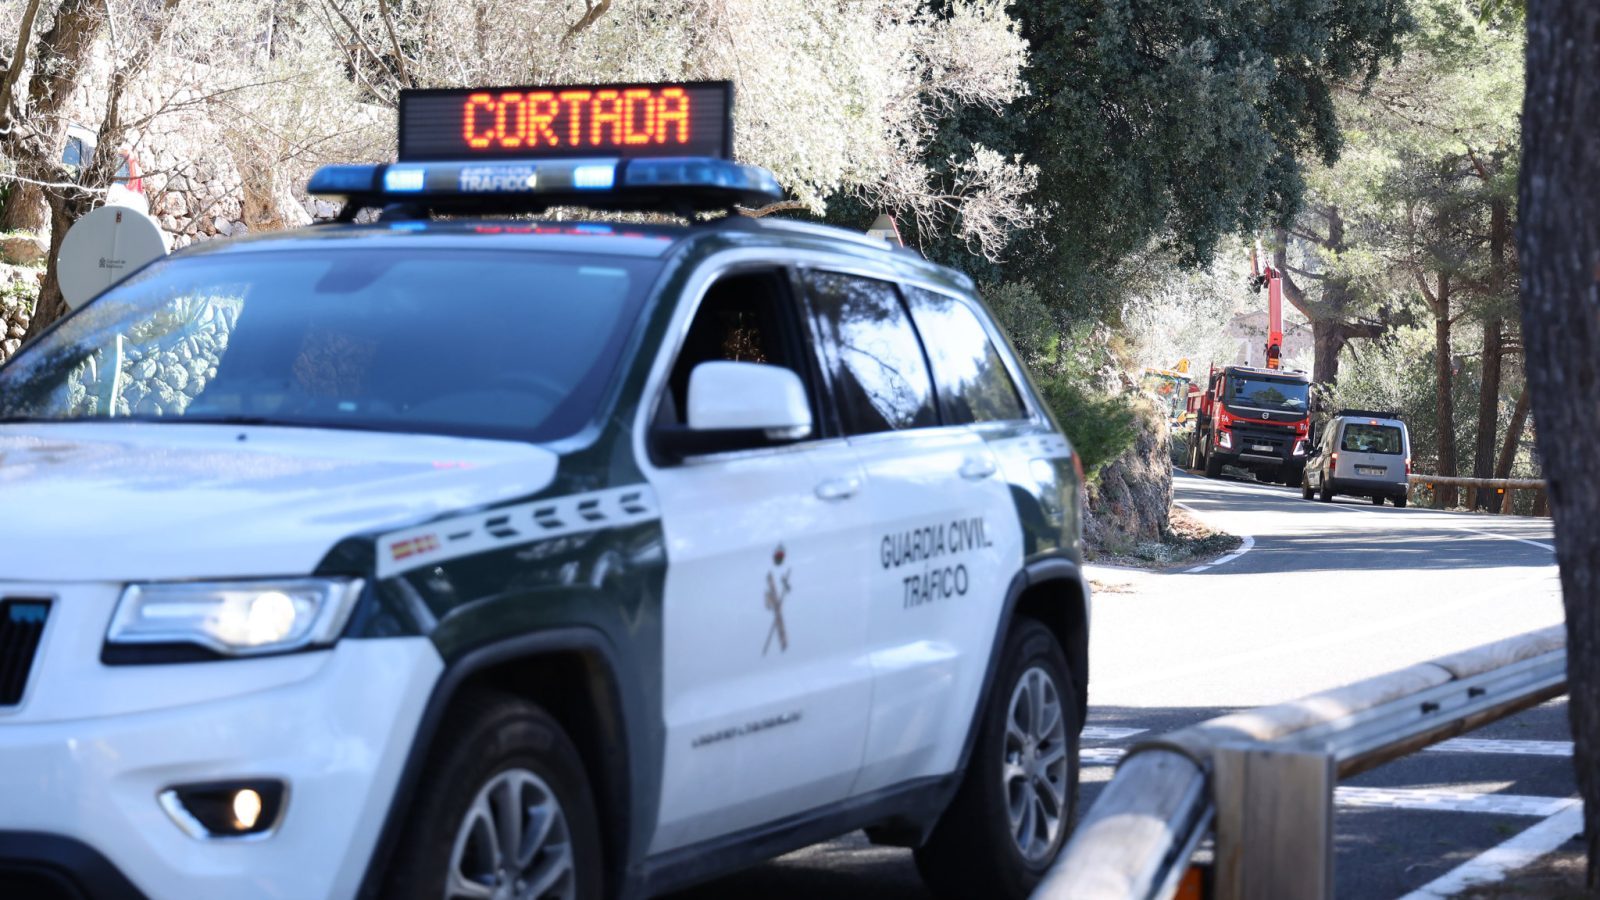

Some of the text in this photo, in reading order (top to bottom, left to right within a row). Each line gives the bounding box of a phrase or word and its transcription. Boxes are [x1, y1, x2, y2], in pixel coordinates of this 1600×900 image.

[463, 87, 690, 149] CORTADA
[880, 517, 993, 570] GUARDIA CIVIL
[902, 563, 969, 610] TRÁFICO
